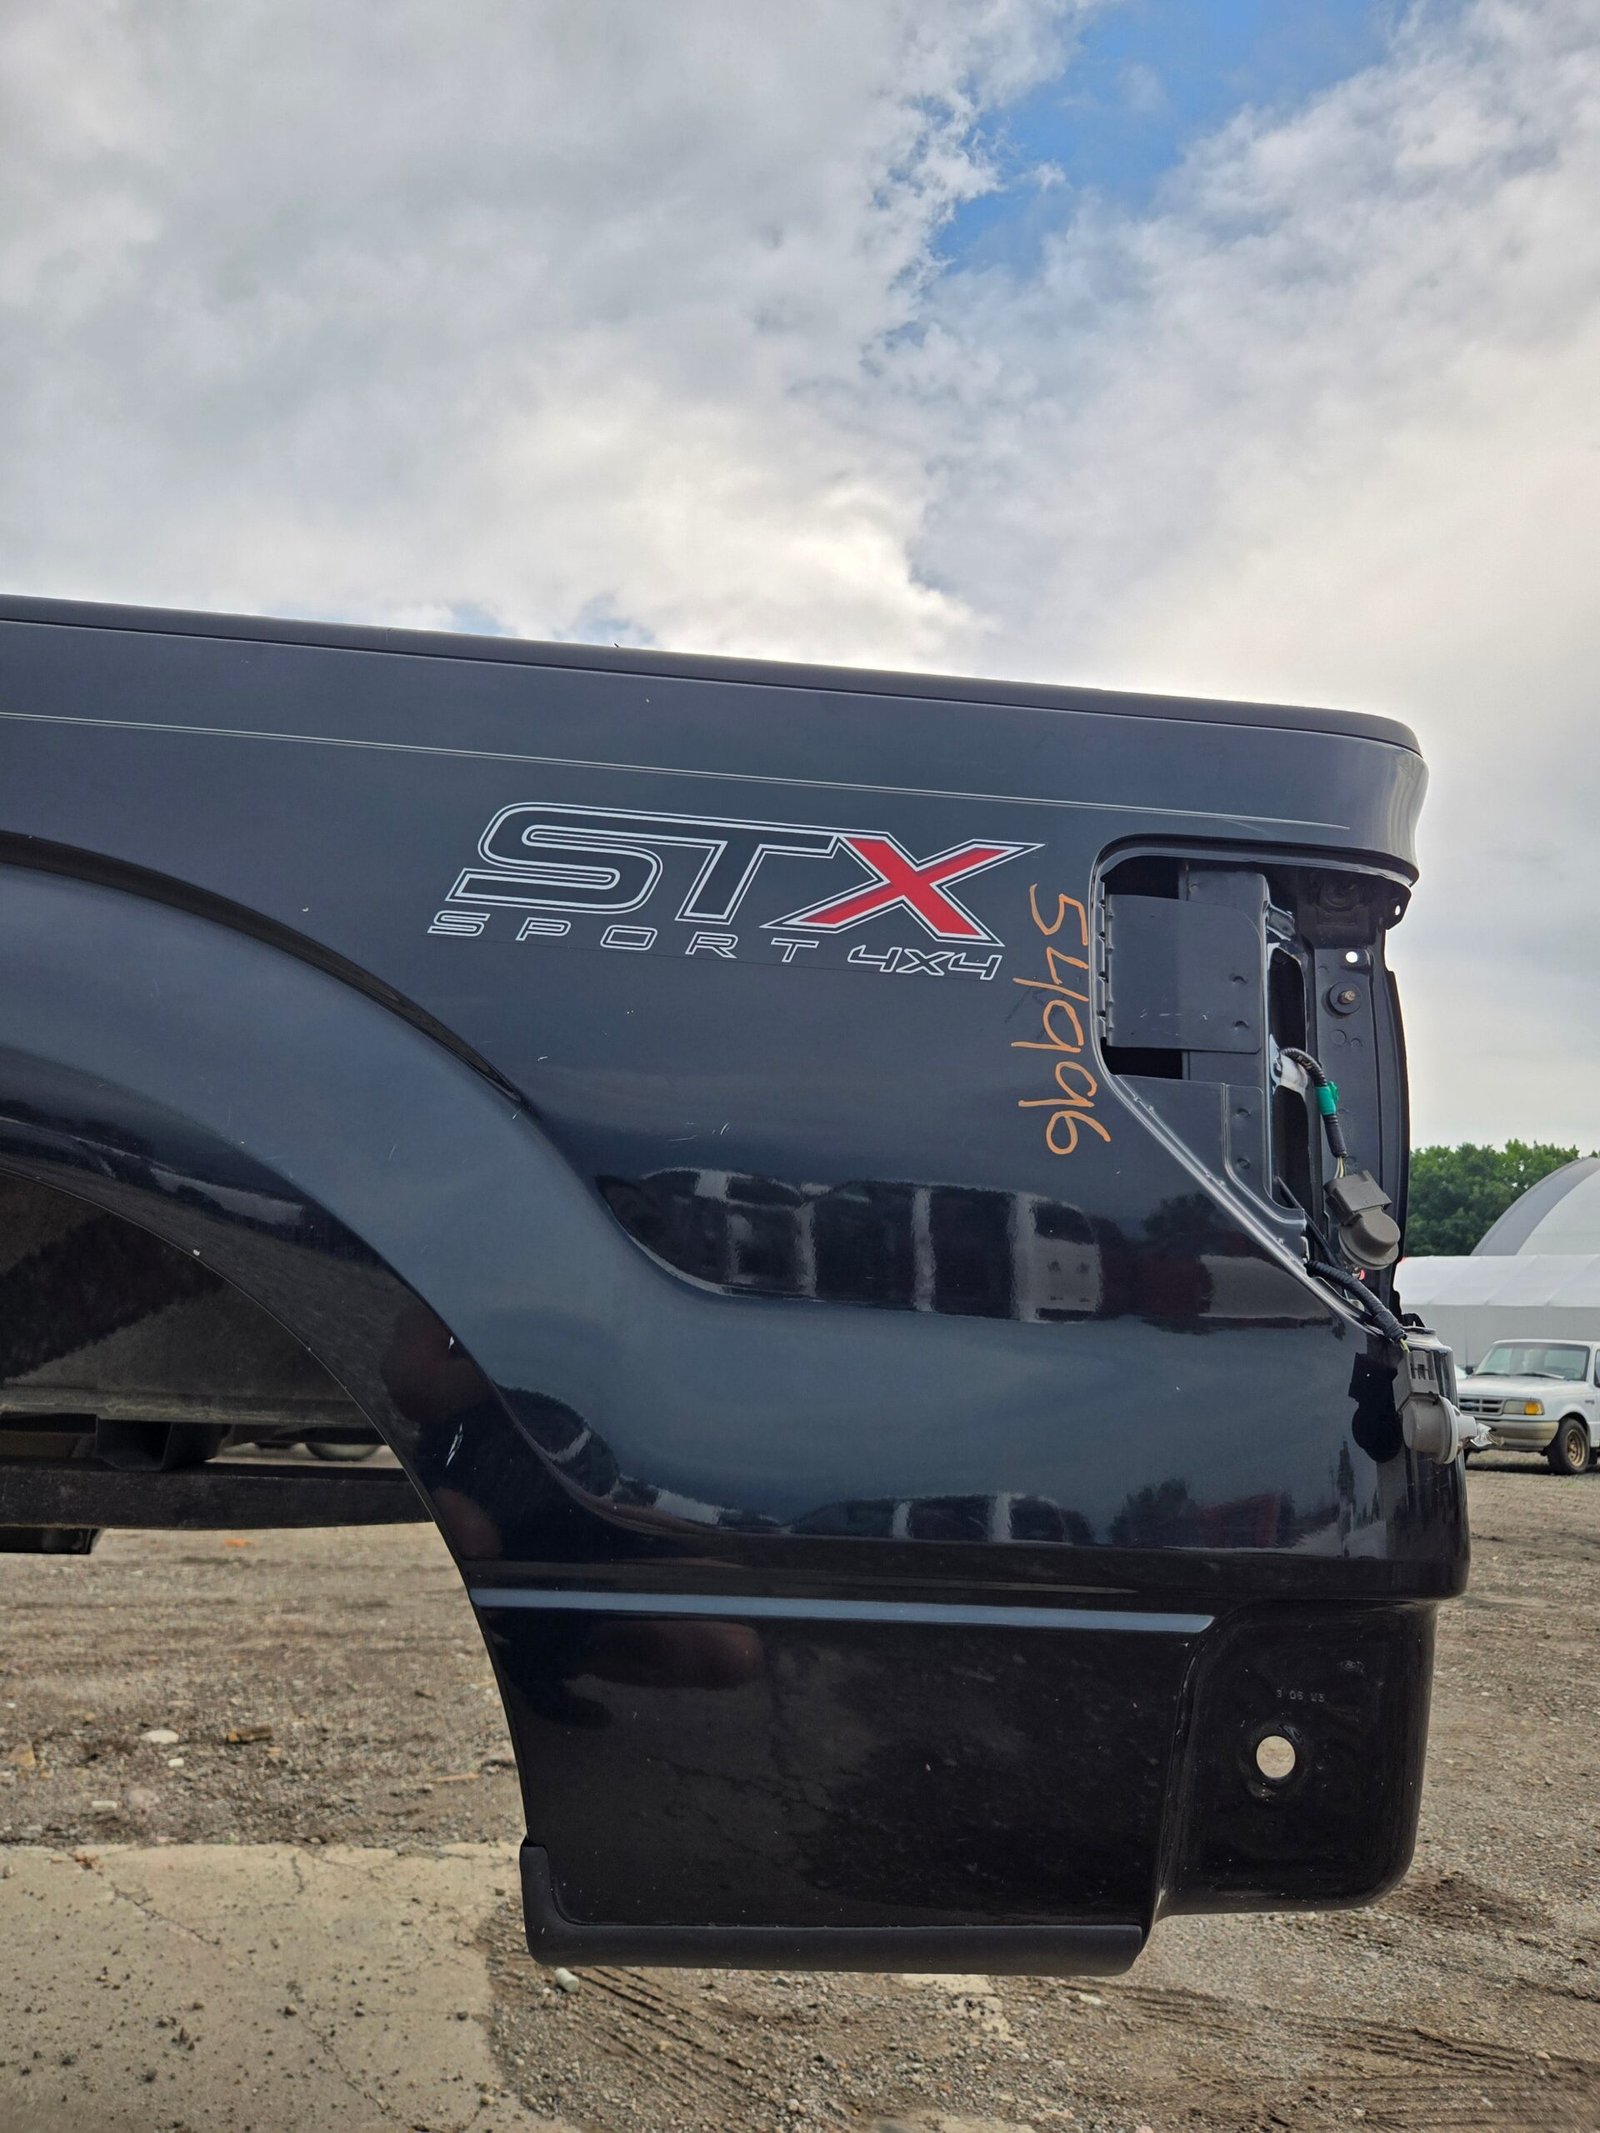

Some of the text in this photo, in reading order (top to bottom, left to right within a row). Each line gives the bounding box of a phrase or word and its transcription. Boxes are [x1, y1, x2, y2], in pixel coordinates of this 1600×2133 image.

[427, 910, 818, 962] SPORT
[446, 802, 1045, 946] STX
[1011, 883, 1111, 1154] 54996
